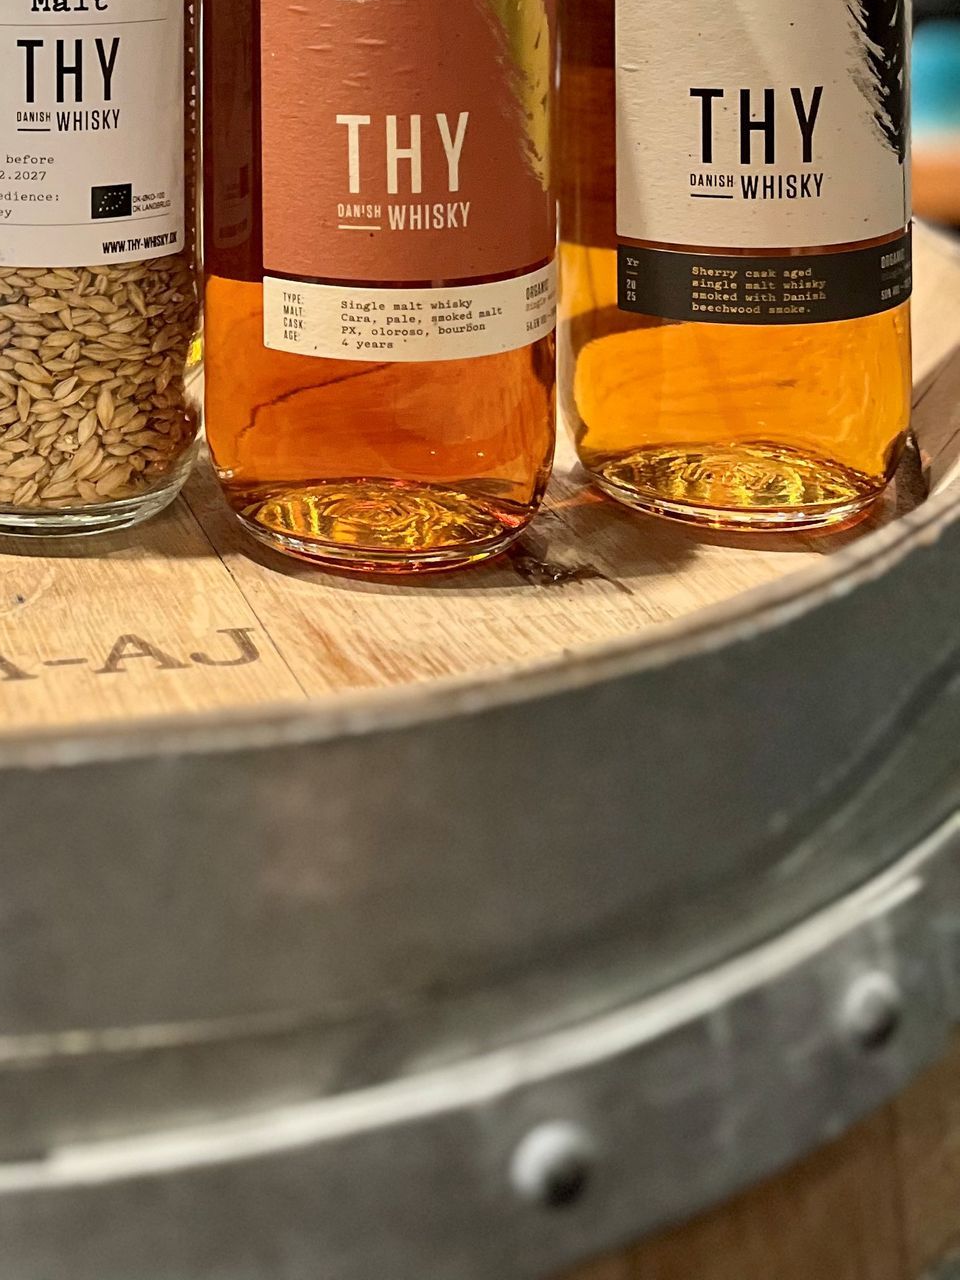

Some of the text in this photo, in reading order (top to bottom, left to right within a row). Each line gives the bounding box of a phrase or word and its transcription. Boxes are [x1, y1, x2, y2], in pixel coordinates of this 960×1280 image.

[16, 37, 121, 104] THY
[16, 109, 121, 132] DANISH WHISKY
[690, 86, 824, 165] THY
[6, 153, 55, 165] before
[336, 111, 470, 194] THY
[690, 173, 824, 200] DANISH WHISKY
[337, 201, 471, 231] DANISH WHISKY
[691, 266, 812, 279] Sherry cask aged
[691, 279, 826, 291] single malt whisky
[282, 292, 305, 305] TYPE:
[691, 291, 826, 302] smoked with Danish
[340, 298, 473, 312] Single malt whisky
[691, 302, 811, 315] beechwood smoke.
[340, 306, 503, 325] Cara, pale, smoked malt
[341, 322, 486, 337] PX, oloroso, bourbon
[341, 338, 394, 350] 4 years
